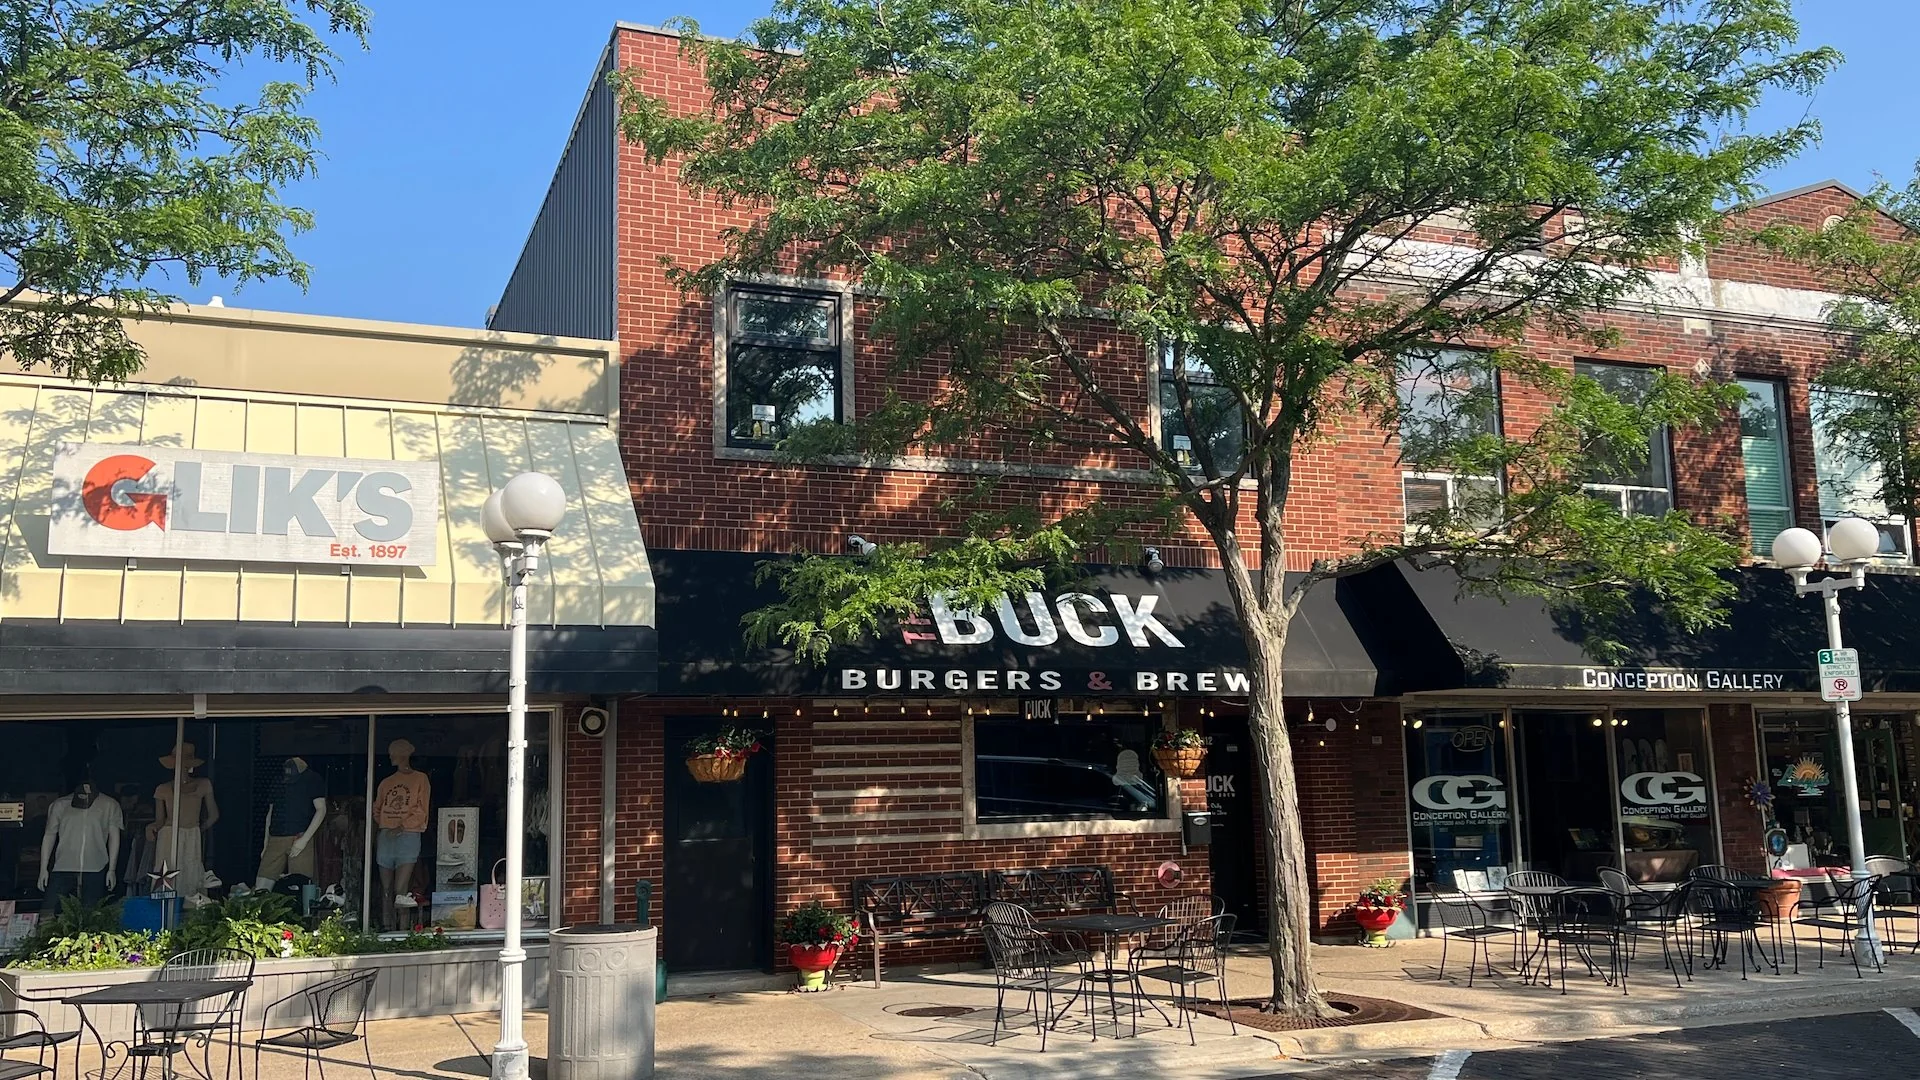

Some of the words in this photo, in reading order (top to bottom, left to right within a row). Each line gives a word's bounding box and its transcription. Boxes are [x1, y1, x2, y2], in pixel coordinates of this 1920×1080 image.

[82, 454, 413, 542] GLIK'S
[330, 543, 361, 558] Est.
[369, 545, 407, 559] 1897
[928, 591, 1185, 647] BUCK
[1822, 652, 1831, 662] 3
[842, 669, 1062, 691] BURGERS
[1087, 671, 1113, 690] &
[1583, 668, 1699, 689] CONCEPTION
[1706, 670, 1784, 690] GALLERY
[1452, 729, 1496, 748] OPEN
[1413, 811, 1468, 821] CONCEPTION
[1470, 809, 1508, 819] GALLERY
[1622, 806, 1672, 815] CONCEPTION
[1673, 805, 1708, 813] GALLERY
